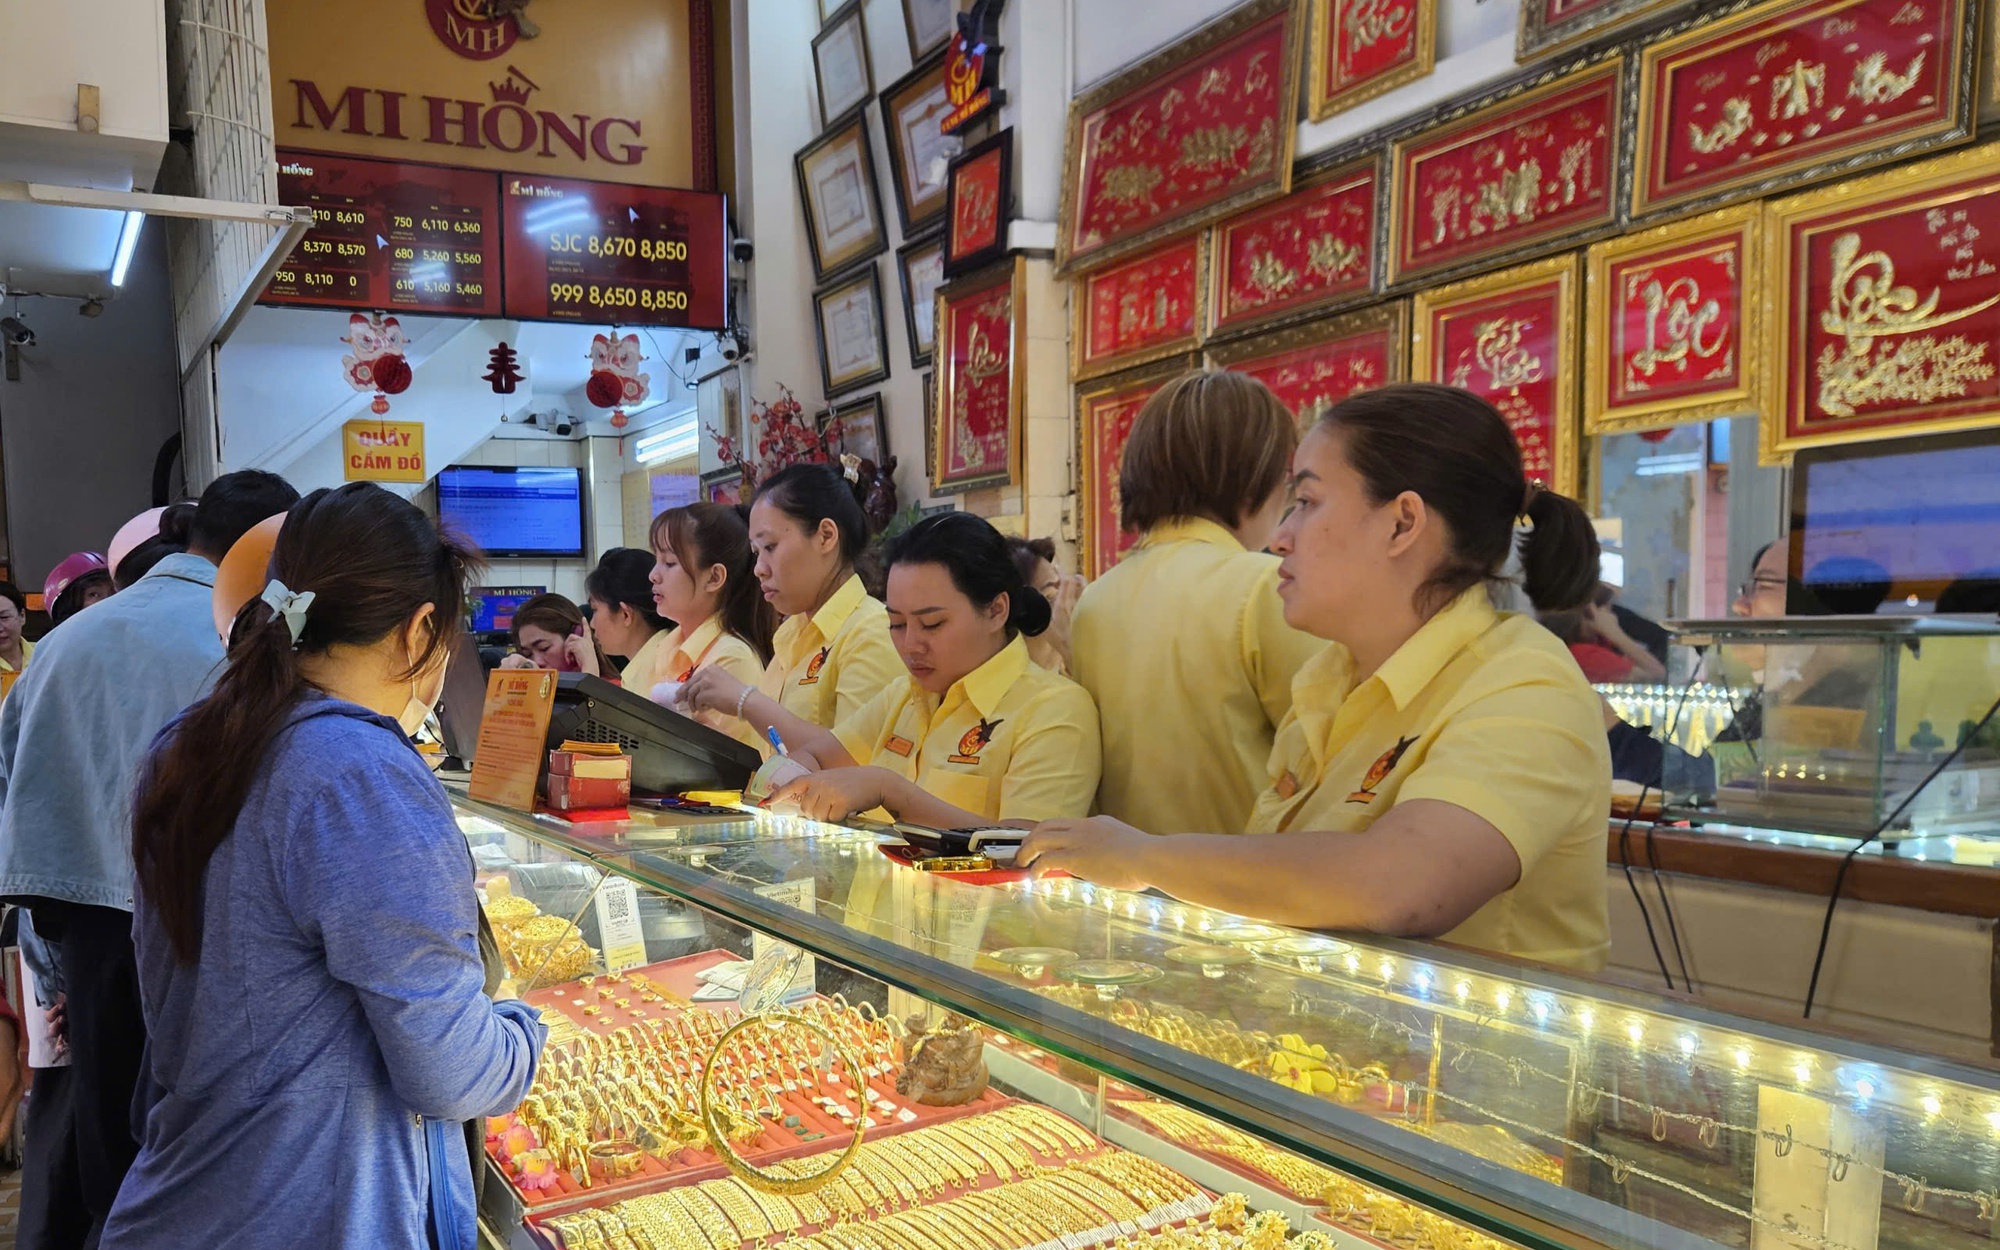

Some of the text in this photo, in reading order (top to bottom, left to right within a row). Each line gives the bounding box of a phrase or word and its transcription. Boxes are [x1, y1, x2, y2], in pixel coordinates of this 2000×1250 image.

[444, 9, 505, 52] MH
[289, 79, 408, 140] MI
[312, 209, 364, 224] 410 8,610
[394, 216, 480, 234] 750 6,110 6,360
[304, 241, 365, 256] 8,370 8,570
[551, 233, 687, 262] SJC 8,670 8,850
[395, 248, 481, 266] 680 5,260 5,560
[275, 271, 357, 287] 950 8,110 0
[396, 279, 482, 296] 610 5,160 5,460
[551, 283, 687, 312] 999 8,650 8,850
[1632, 277, 1727, 376] Lộc
